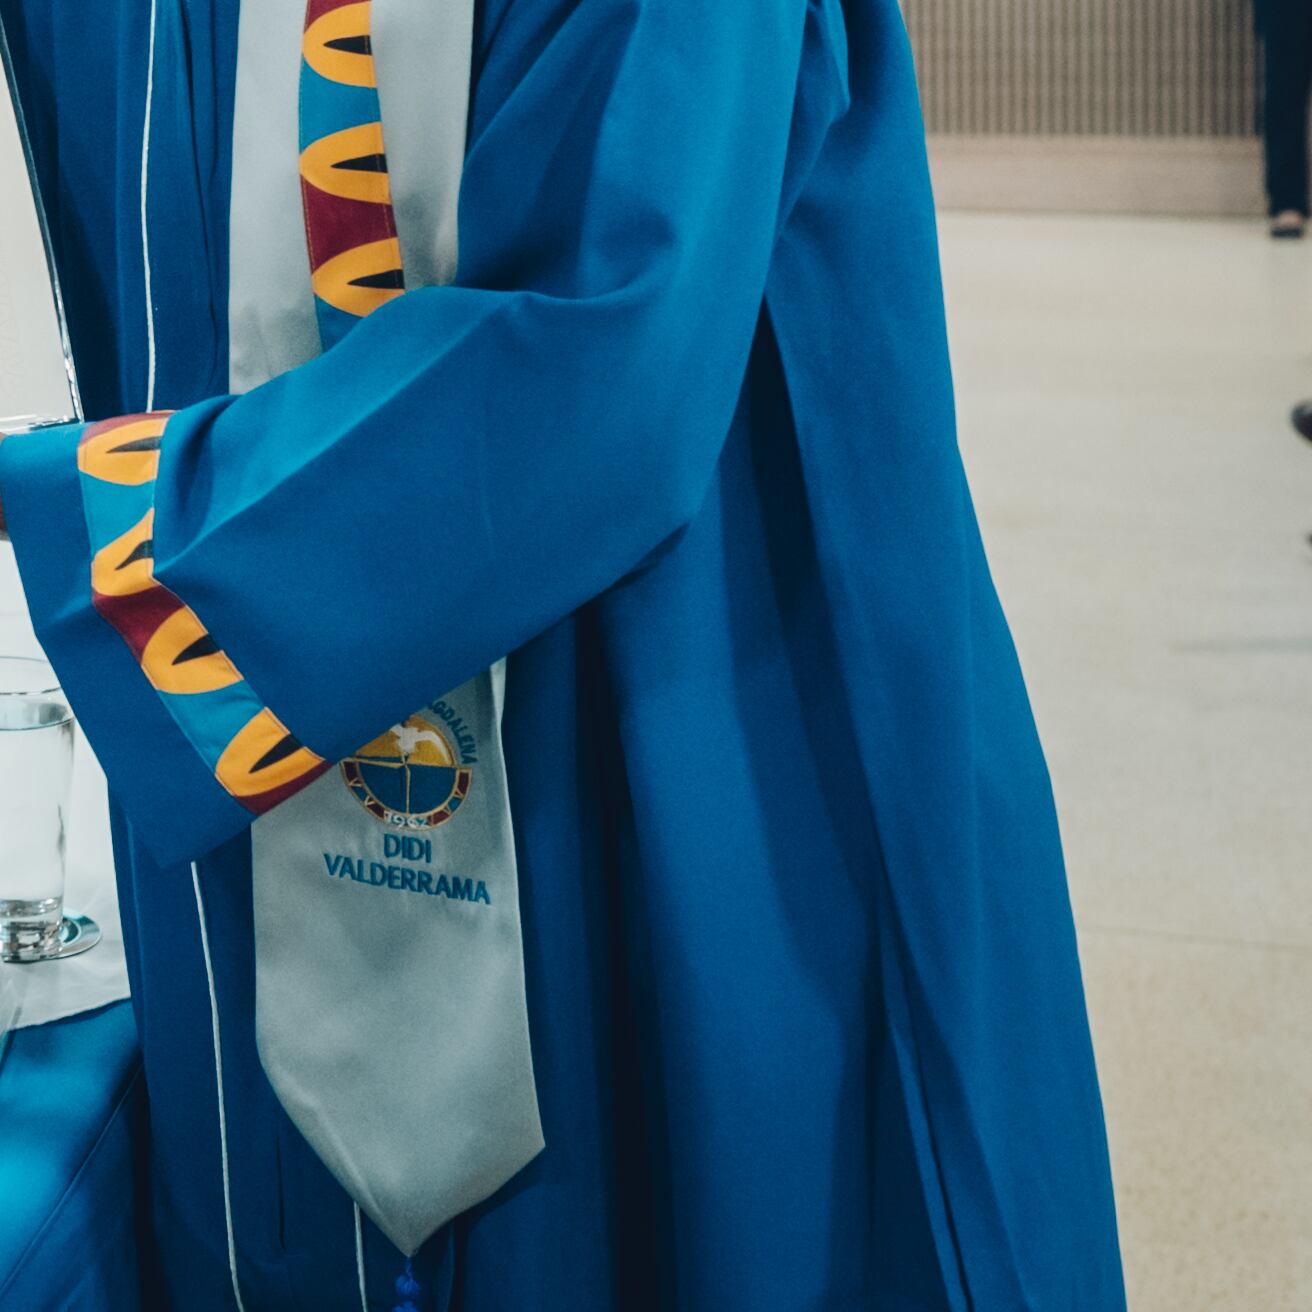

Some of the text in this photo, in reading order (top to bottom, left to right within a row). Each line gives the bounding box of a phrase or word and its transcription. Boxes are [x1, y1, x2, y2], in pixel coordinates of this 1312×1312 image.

[430, 700, 479, 765] GDALENA
[383, 833, 432, 864] DIDI
[323, 852, 491, 906] VALDERRAMA
